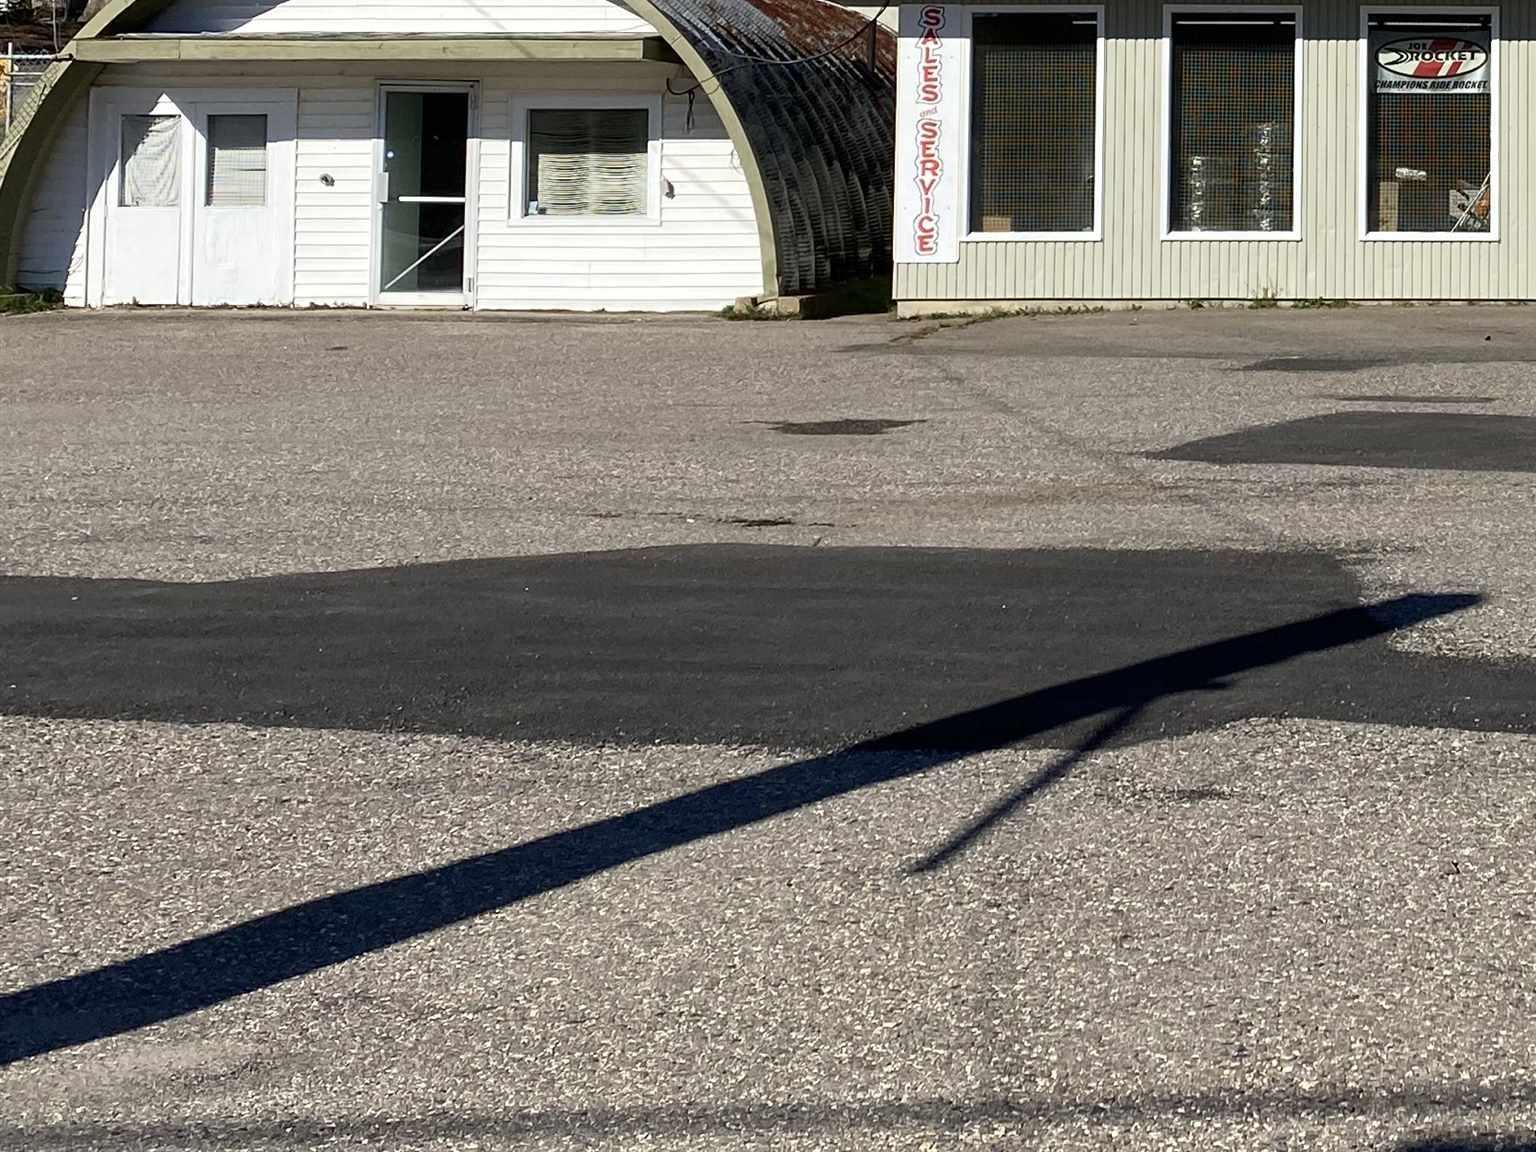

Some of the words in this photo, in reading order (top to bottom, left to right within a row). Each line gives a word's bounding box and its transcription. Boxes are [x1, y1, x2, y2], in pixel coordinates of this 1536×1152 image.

[920, 6, 943, 103] SALES
[1409, 51, 1476, 61] ROCKET
[1375, 80, 1428, 89] CHAMPIONS
[1429, 80, 1451, 89] RIDE
[919, 106, 938, 118] and
[917, 122, 942, 252] SERVICE
